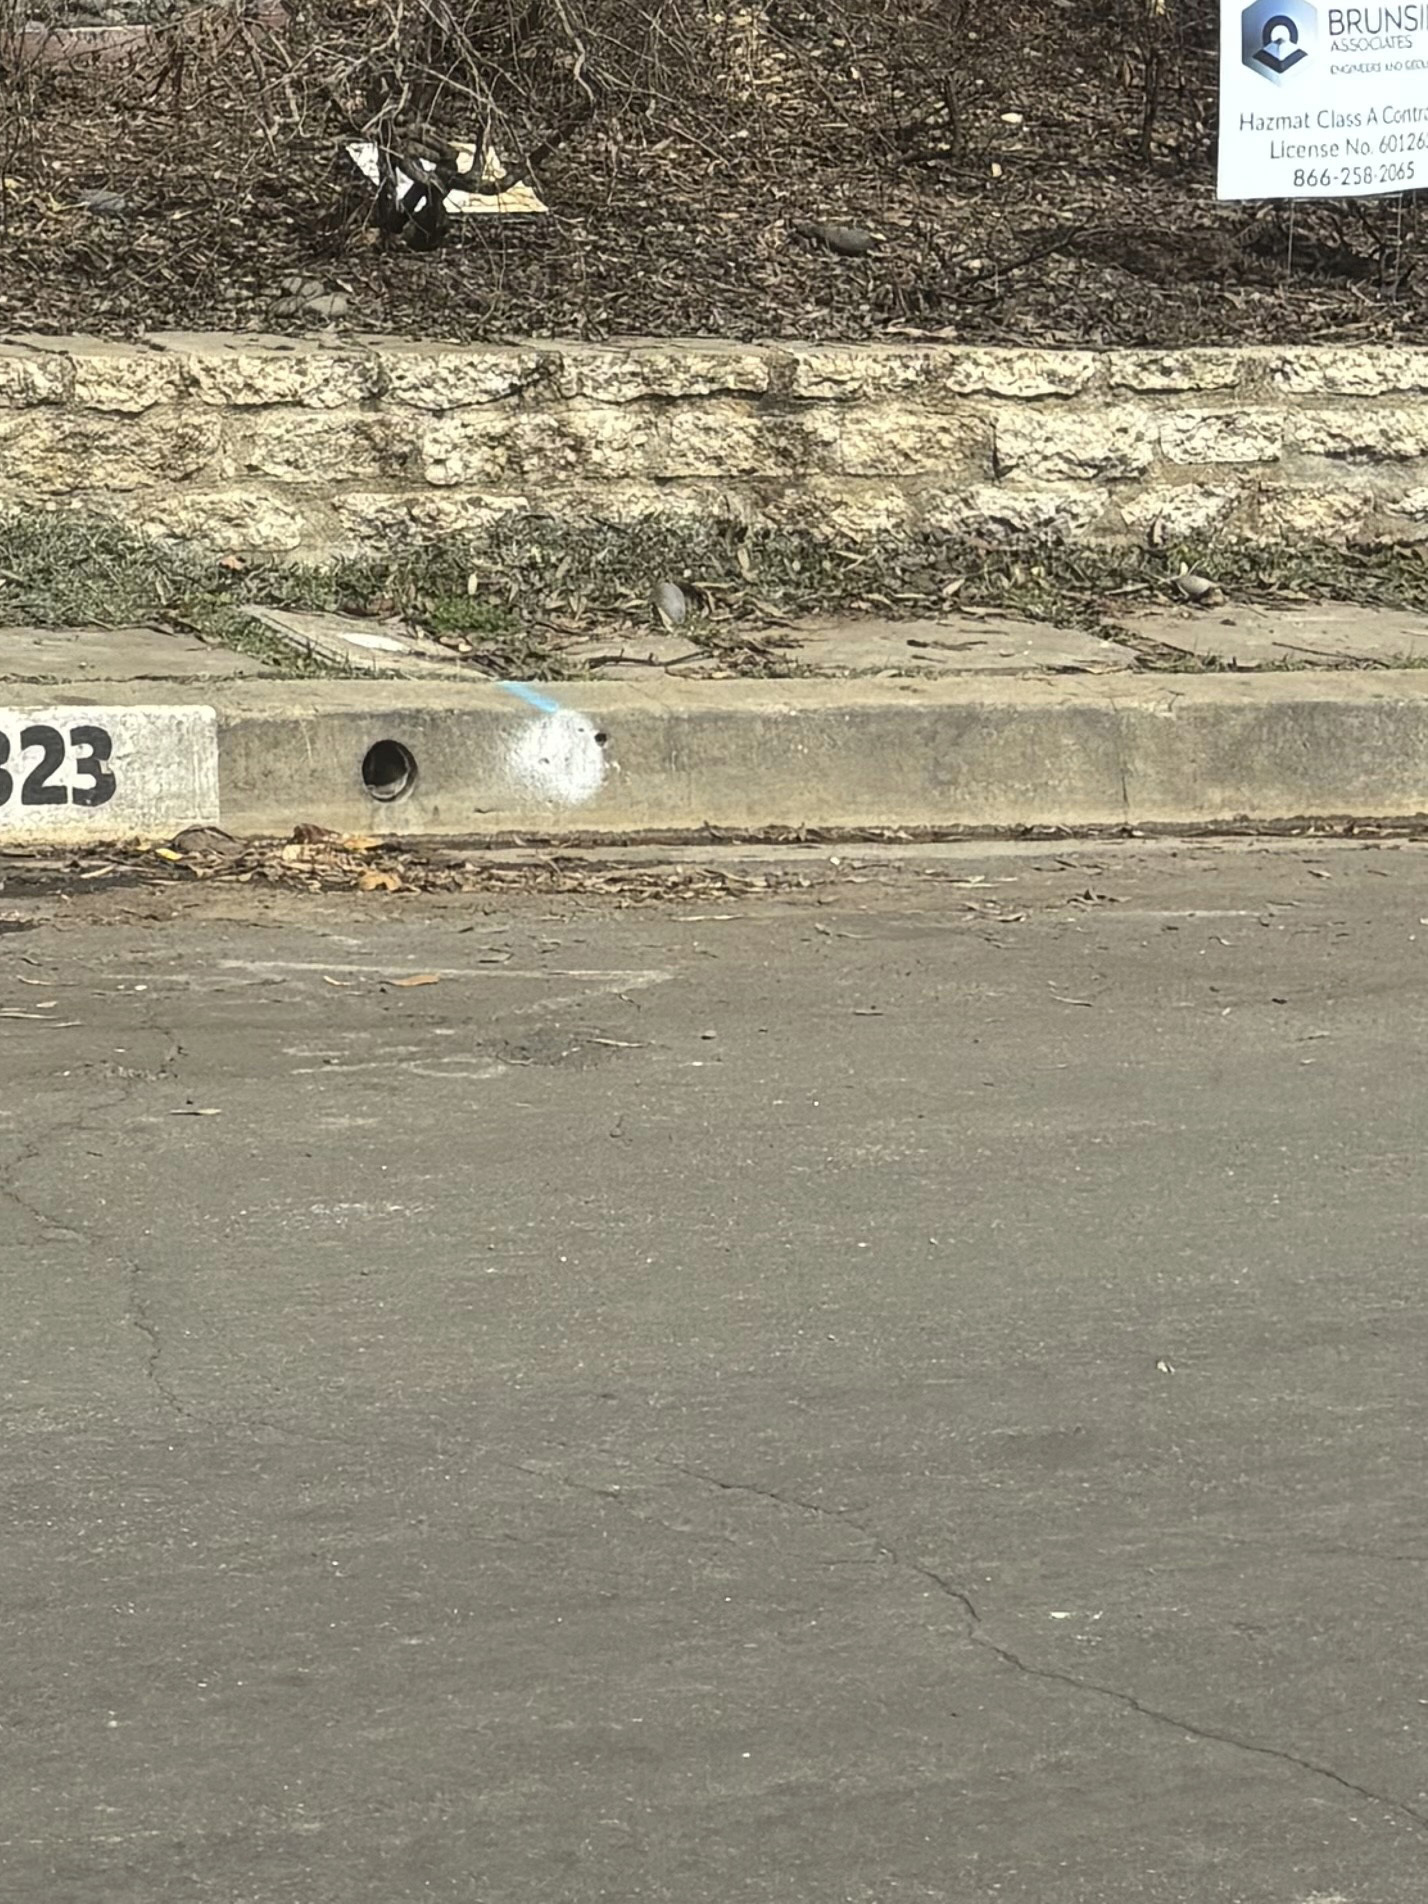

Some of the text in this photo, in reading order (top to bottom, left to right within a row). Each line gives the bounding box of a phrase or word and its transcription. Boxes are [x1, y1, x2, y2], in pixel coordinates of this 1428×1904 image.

[1328, 4, 1428, 36] BRUNSI
[1239, 112, 1310, 131] Hazmat
[1317, 109, 1362, 129] Class
[1366, 107, 1378, 126] A
[1270, 132, 1428, 159] License No. 60126
[1293, 161, 1415, 187] 866-258-2065
